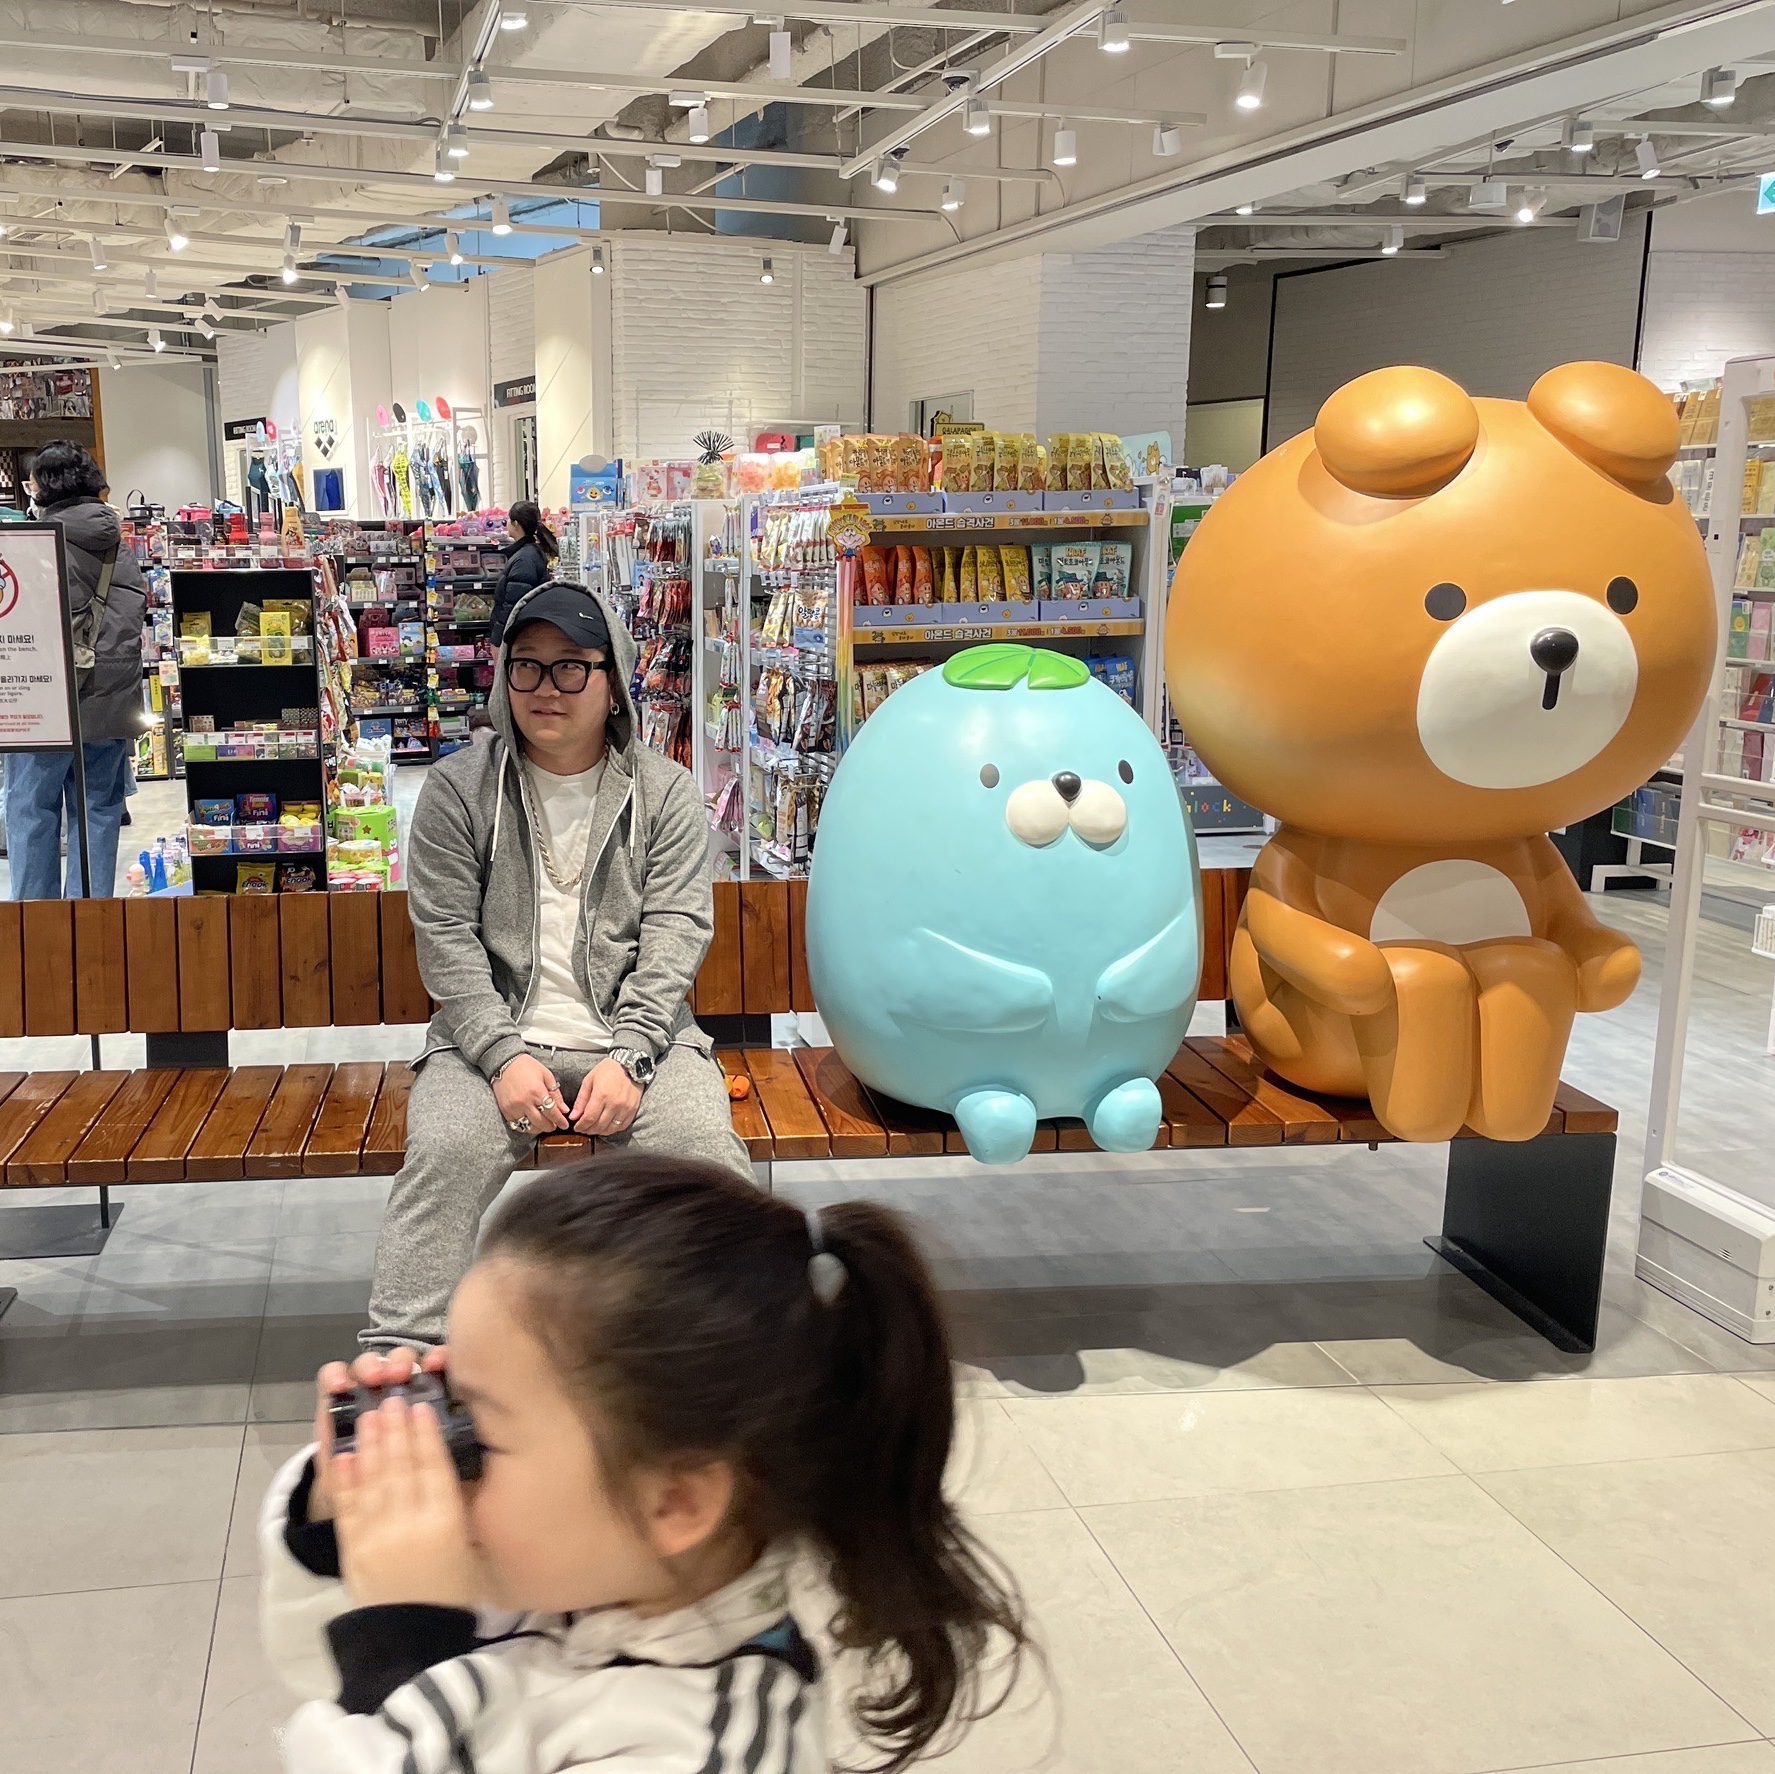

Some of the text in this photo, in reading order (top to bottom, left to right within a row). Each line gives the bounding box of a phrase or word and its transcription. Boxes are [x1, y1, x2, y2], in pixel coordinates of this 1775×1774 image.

[506, 386, 524, 398] FITTING
[313, 419, 334, 434] arena
[926, 518, 955, 529] 아몬드
[956, 517, 995, 528] 습격사건
[7, 634, 35, 644] 마세요!
[924, 630, 954, 640] 아몬드
[954, 629, 993, 639] 습격사건
[29, 675, 53, 683] 마세요!
